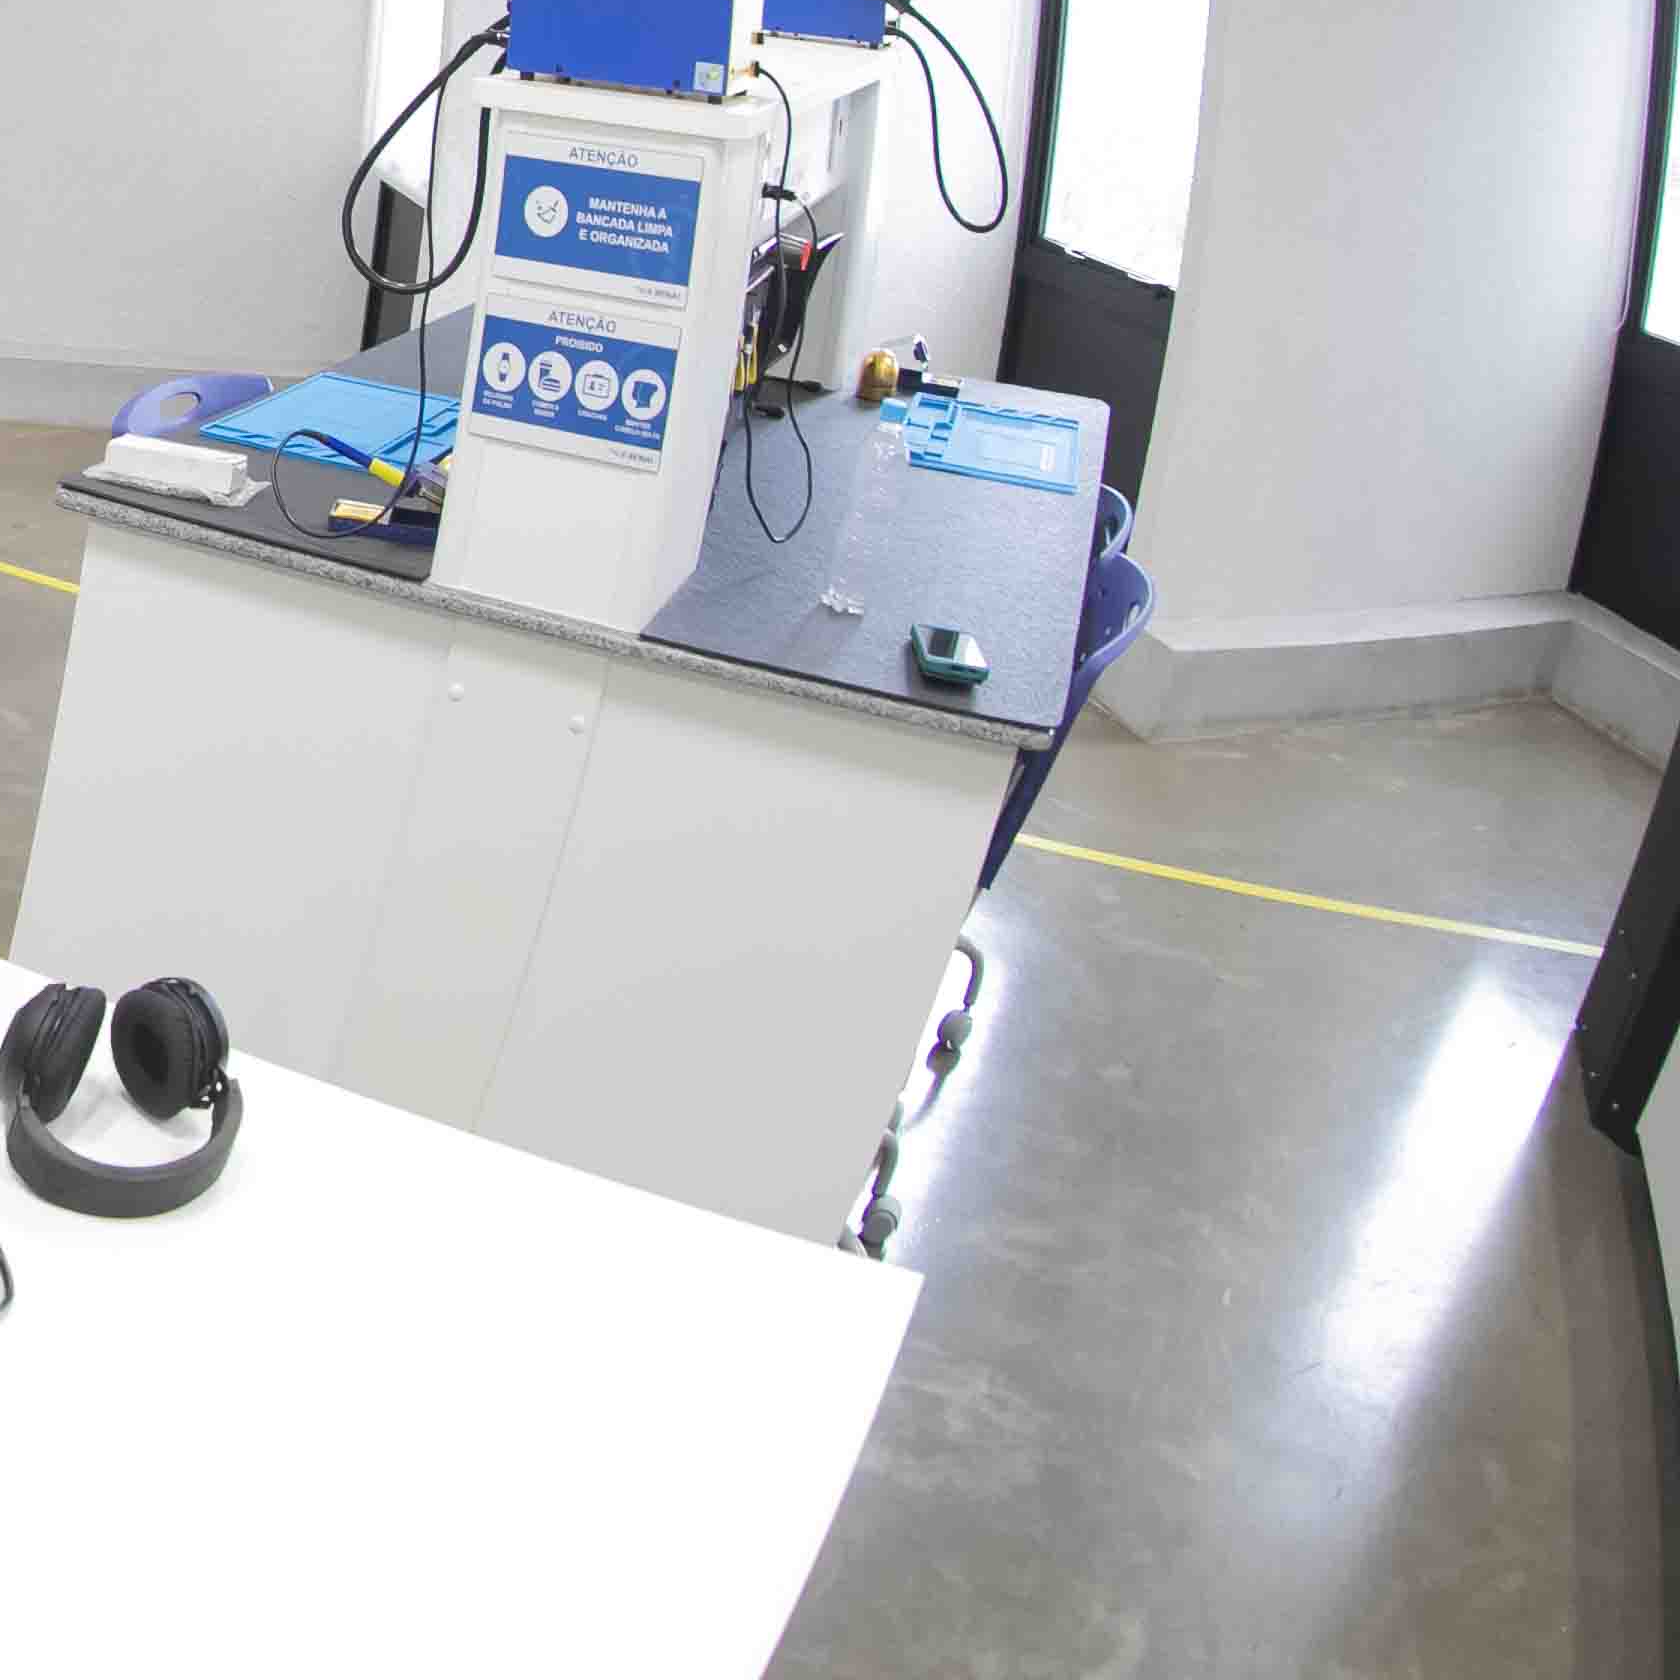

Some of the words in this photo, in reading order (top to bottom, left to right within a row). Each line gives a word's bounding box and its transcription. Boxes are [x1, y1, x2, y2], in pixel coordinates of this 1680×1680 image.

[568, 146, 639, 168] ATENÇÃO
[589, 197, 656, 218] MANTENHA
[656, 206, 668, 219] A
[576, 211, 636, 231] BANCADA
[637, 219, 673, 238] LIMPA
[578, 228, 589, 241] E
[591, 231, 670, 253] ORGANIZADA
[548, 310, 617, 333] ATENÇÃO
